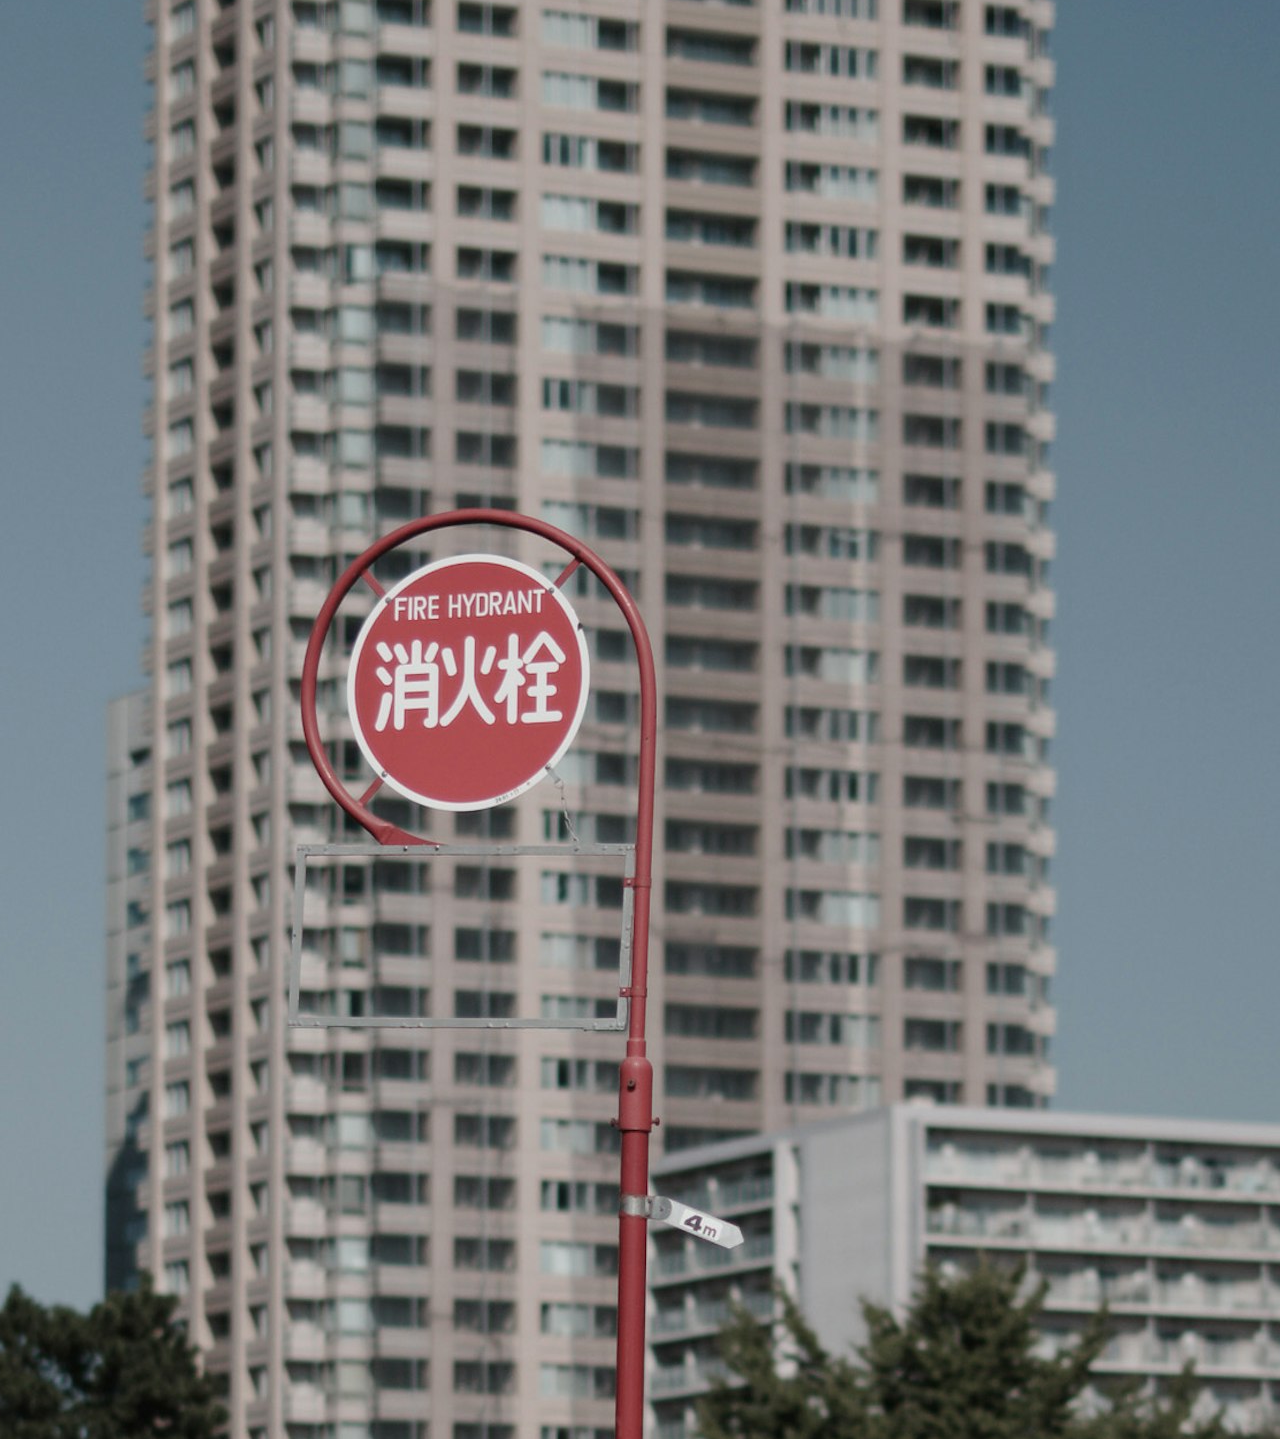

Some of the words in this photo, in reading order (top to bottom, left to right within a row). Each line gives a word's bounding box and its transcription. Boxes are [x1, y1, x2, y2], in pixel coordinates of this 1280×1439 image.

[393, 595, 440, 622] FIRE
[448, 588, 546, 619] HYDRANT
[375, 630, 567, 733] 消火栓
